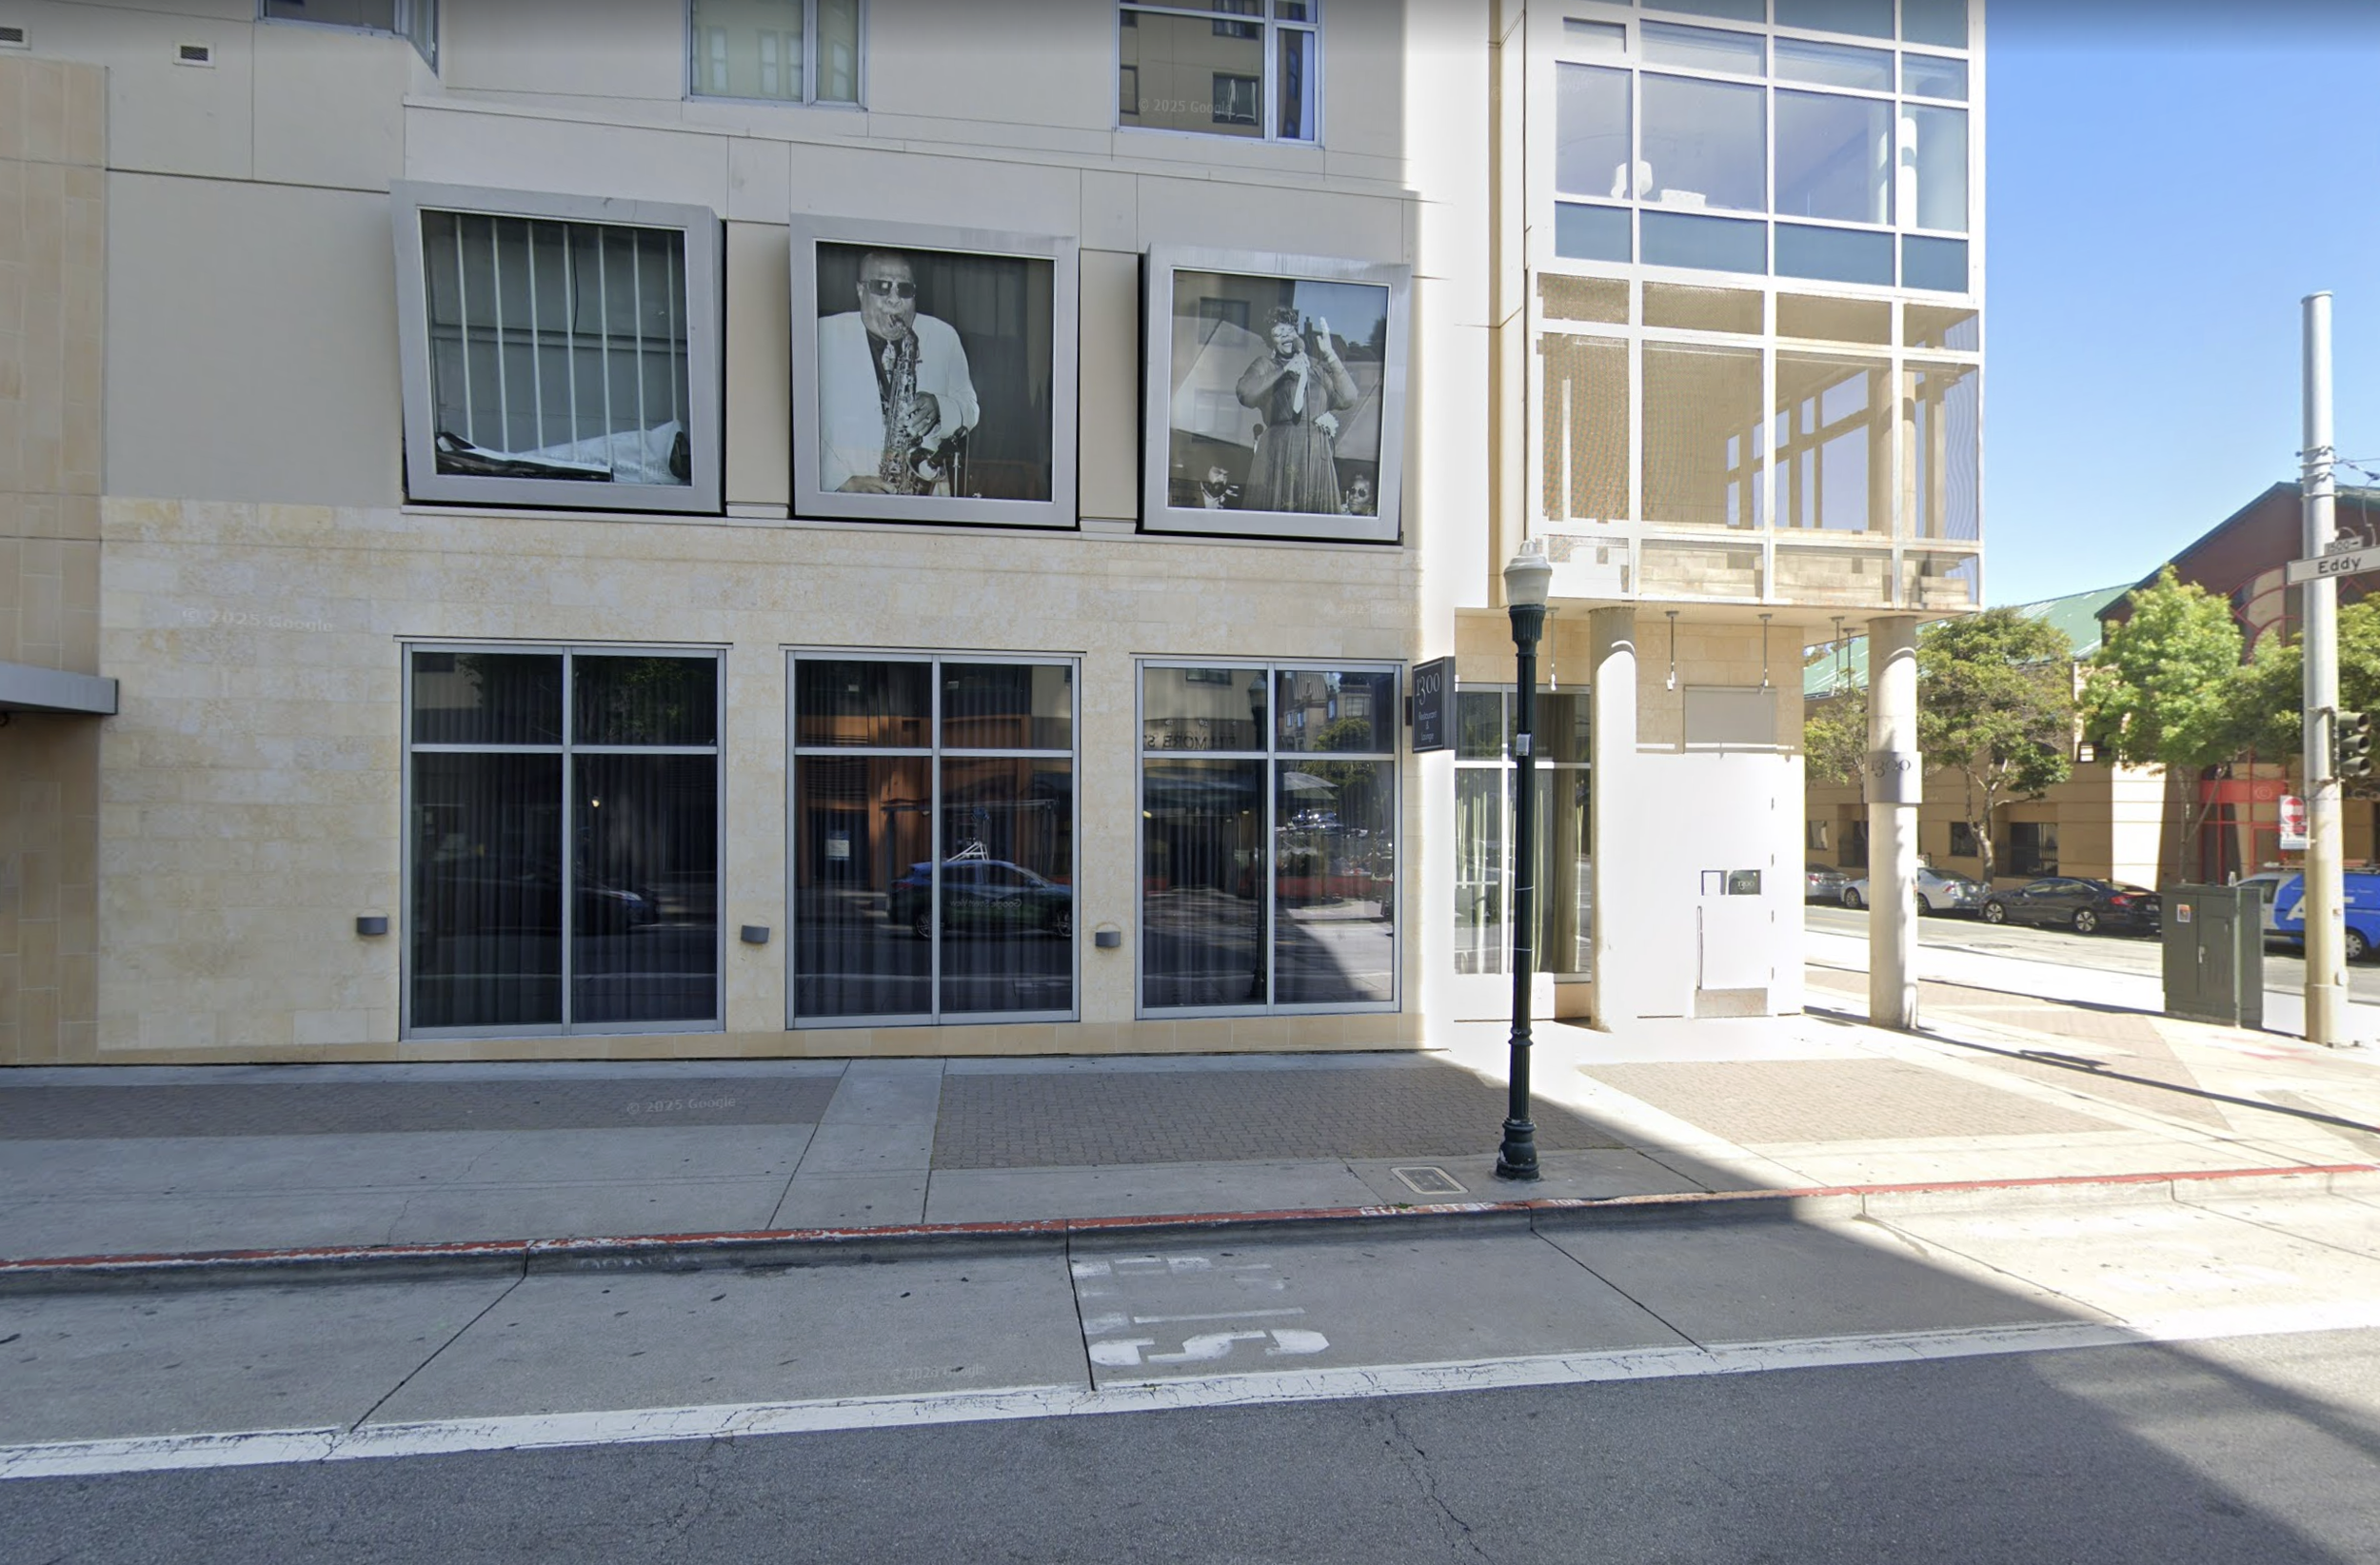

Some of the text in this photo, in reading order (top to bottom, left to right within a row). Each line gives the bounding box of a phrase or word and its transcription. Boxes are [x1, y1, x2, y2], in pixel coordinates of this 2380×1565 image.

[2318, 557, 2361, 574] Eddy
[1417, 672, 1440, 705] 1300
[1870, 759, 1912, 779] 1300
